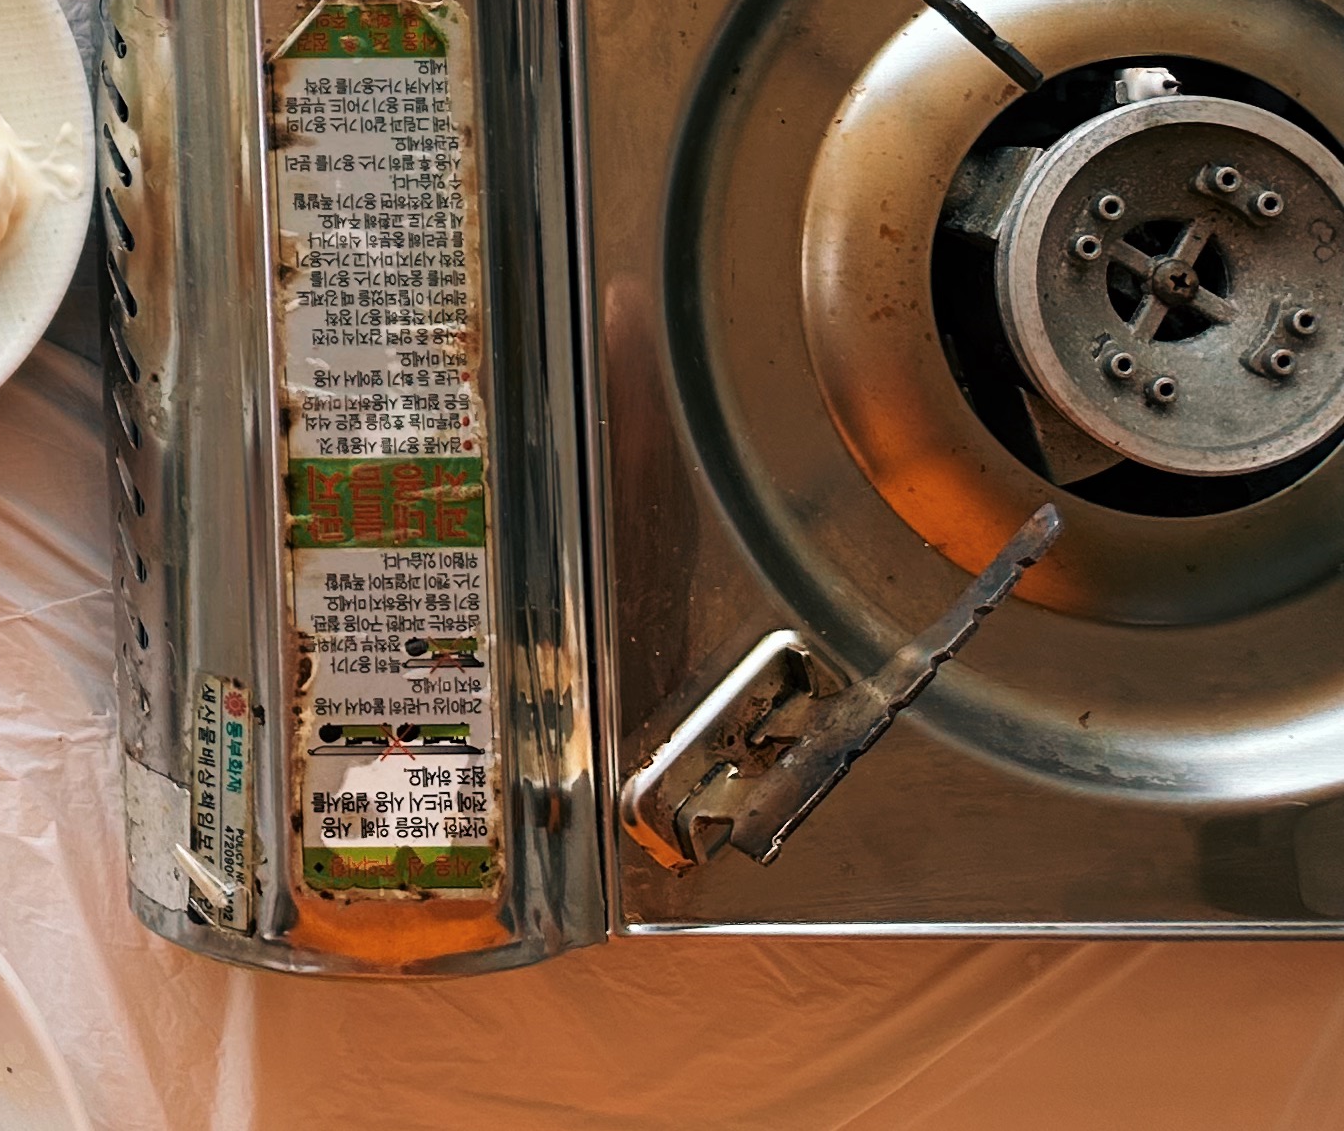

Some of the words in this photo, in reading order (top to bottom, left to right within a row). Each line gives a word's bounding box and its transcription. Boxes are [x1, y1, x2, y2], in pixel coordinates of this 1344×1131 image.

[305, 77, 331, 94] 장착
[285, 96, 325, 114] 부분을
[328, 96, 368, 114] 가이드
[373, 96, 398, 114] 용기
[402, 96, 428, 114] 밸브
[286, 116, 326, 133] 용기의
[330, 116, 357, 133] 가스
[361, 116, 387, 133] 같이
[390, 116, 429, 133] 그림과
[285, 155, 311, 172] 분리
[315, 155, 354, 172] 용기를
[359, 155, 385, 172] 가스
[389, 155, 415, 172] 필히
[418, 155, 431, 172] 후
[435, 155, 460, 172] 사용
[389, 173, 445, 190] 있습니다.
[448, 173, 461, 190] 수
[293, 192, 333, 210] 폭발할
[337, 192, 376, 210] 용기가
[380, 192, 433, 210] 장착하면
[437, 192, 463, 210] 강제
[364, 212, 404, 228] 교환해
[408, 212, 447, 228] 용기로
[450, 212, 463, 228] 새
[308, 232, 361, 248] 식히거나
[365, 232, 404, 248] 충분히
[408, 232, 447, 248] 분리해
[451, 232, 463, 248] 를
[352, 251, 392, 268] 마시고
[397, 251, 435, 268] 시키지
[439, 251, 465, 268] 장착
[310, 270, 349, 288] 용기를
[353, 270, 380, 288] 가스
[384, 270, 422, 288] 움직여
[427, 270, 465, 288] 레버를
[296, 289, 337, 306] 강제로
[341, 289, 354, 306] 때
[358, 289, 423, 306] 이탈되었을
[427, 289, 467, 306] 레버가
[325, 308, 352, 325] 장착
[356, 308, 381, 325] 용기
[385, 308, 424, 325] 작동해
[428, 308, 467, 325] 장치가
[312, 328, 338, 345] 안전
[343, 328, 382, 345] 감지식
[386, 328, 411, 345] 압력
[415, 328, 428, 345] 중
[443, 350, 467, 367] 하지
[314, 370, 340, 387] 사용
[344, 370, 382, 387] 옆에서
[388, 370, 413, 387] 화기
[417, 370, 429, 387] 등
[433, 370, 459, 387] 난로
[345, 394, 397, 411] 사용하지
[400, 394, 440, 411] 절대로
[444, 394, 469, 411] 등은
[302, 412, 331, 431] 석쇠,
[336, 412, 361, 431] 덮은
[365, 412, 405, 431] 호일을
[409, 412, 460, 431] 알루미늄
[337, 437, 376, 454] 사용할
[380, 437, 419, 454] 용기를
[423, 437, 461, 454] 검사품
[381, 552, 435, 569] 있습니다.
[440, 552, 478, 569] 위험이
[325, 573, 365, 590] 폭발할
[368, 573, 421, 590] 과열되어
[453, 573, 480, 590] 가스
[370, 593, 421, 611] 사용하지
[426, 593, 450, 611] 등을
[454, 593, 480, 611] 용기
[311, 615, 339, 631] 철판,
[343, 615, 383, 631] 구이용
[386, 615, 425, 631] 과대한
[360, 636, 400, 653] 장착부
[331, 656, 370, 673] 용기가
[375, 656, 401, 673] 특히
[455, 677, 480, 693] 하지
[315, 697, 341, 715] 사용
[345, 697, 385, 715] 붙여서
[389, 697, 429, 715] 나란히
[433, 697, 481, 715] 2대이상
[226, 721, 245, 794] 동부화재
[404, 766, 451, 787] 하세요.
[456, 766, 485, 787] 참조
[311, 791, 369, 812] 설명서를
[375, 791, 404, 812] 사용
[409, 791, 452, 812] 반드시
[458, 791, 487, 812] 전에
[322, 817, 352, 838] 사용
[361, 817, 389, 838] 위해
[395, 817, 439, 838] 사용을
[444, 817, 487, 838] 안전한
[235, 828, 246, 868] POLICY
